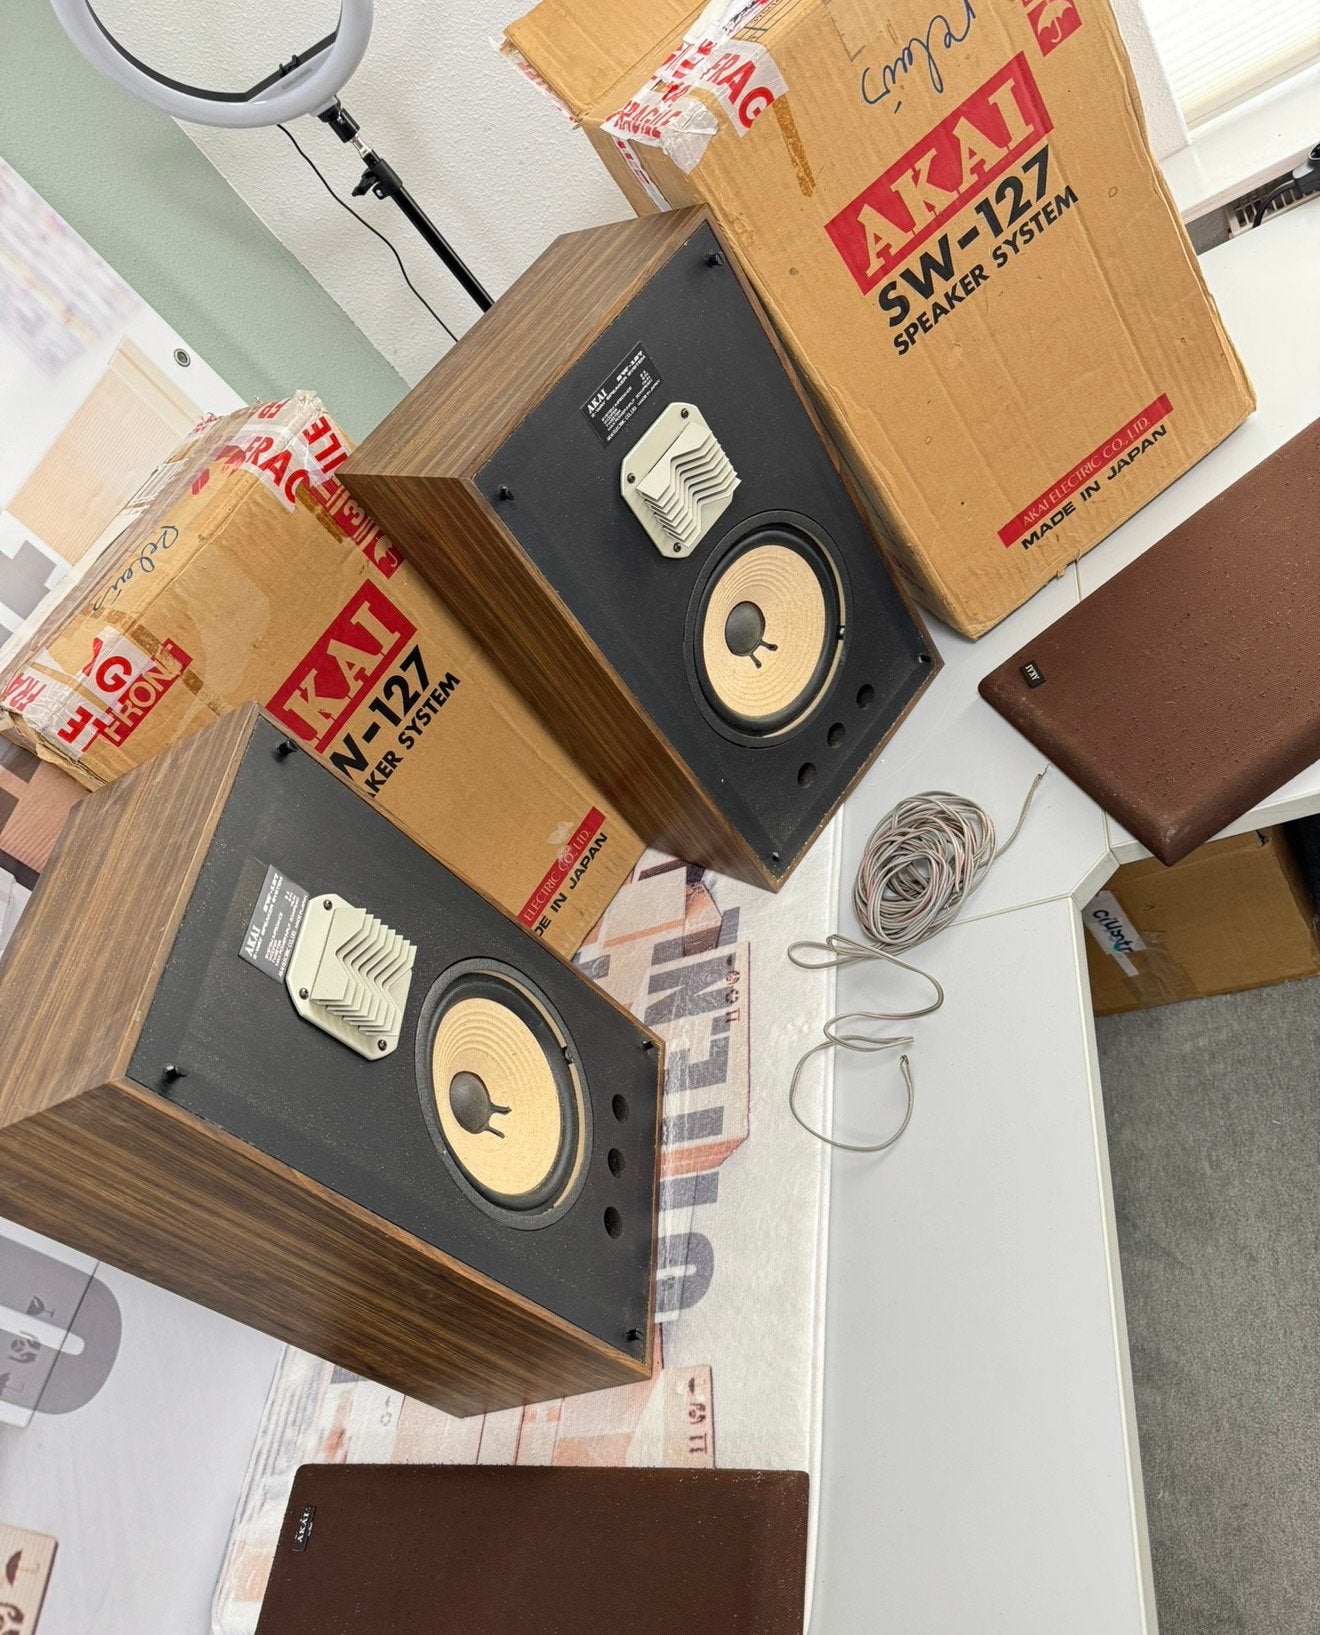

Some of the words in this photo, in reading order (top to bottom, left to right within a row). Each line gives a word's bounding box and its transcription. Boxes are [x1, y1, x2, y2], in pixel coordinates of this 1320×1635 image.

[857, 77, 1035, 278] AKAI
[878, 143, 1049, 328] SW-127
[893, 263, 990, 356] SPEAKER
[992, 184, 1079, 269] SYSTEM
[587, 388, 607, 414] AKAI
[1020, 500, 1077, 551] MADE
[1079, 479, 1102, 502] IN
[1106, 423, 1168, 481] JAPAN
[1022, 499, 1050, 528] AKAI
[1050, 454, 1102, 504] ELECTRIC
[283, 600, 402, 742] KAI
[329, 643, 430, 783] W-127
[397, 671, 461, 750] SYSTEM
[1025, 664, 1040, 680] AKAI
[523, 865, 561, 923] ELECTRIC
[533, 916, 552, 936] DE
[550, 892, 567, 916] IN
[568, 831, 609, 890] JAPAN
[244, 924, 263, 957] AKAI
